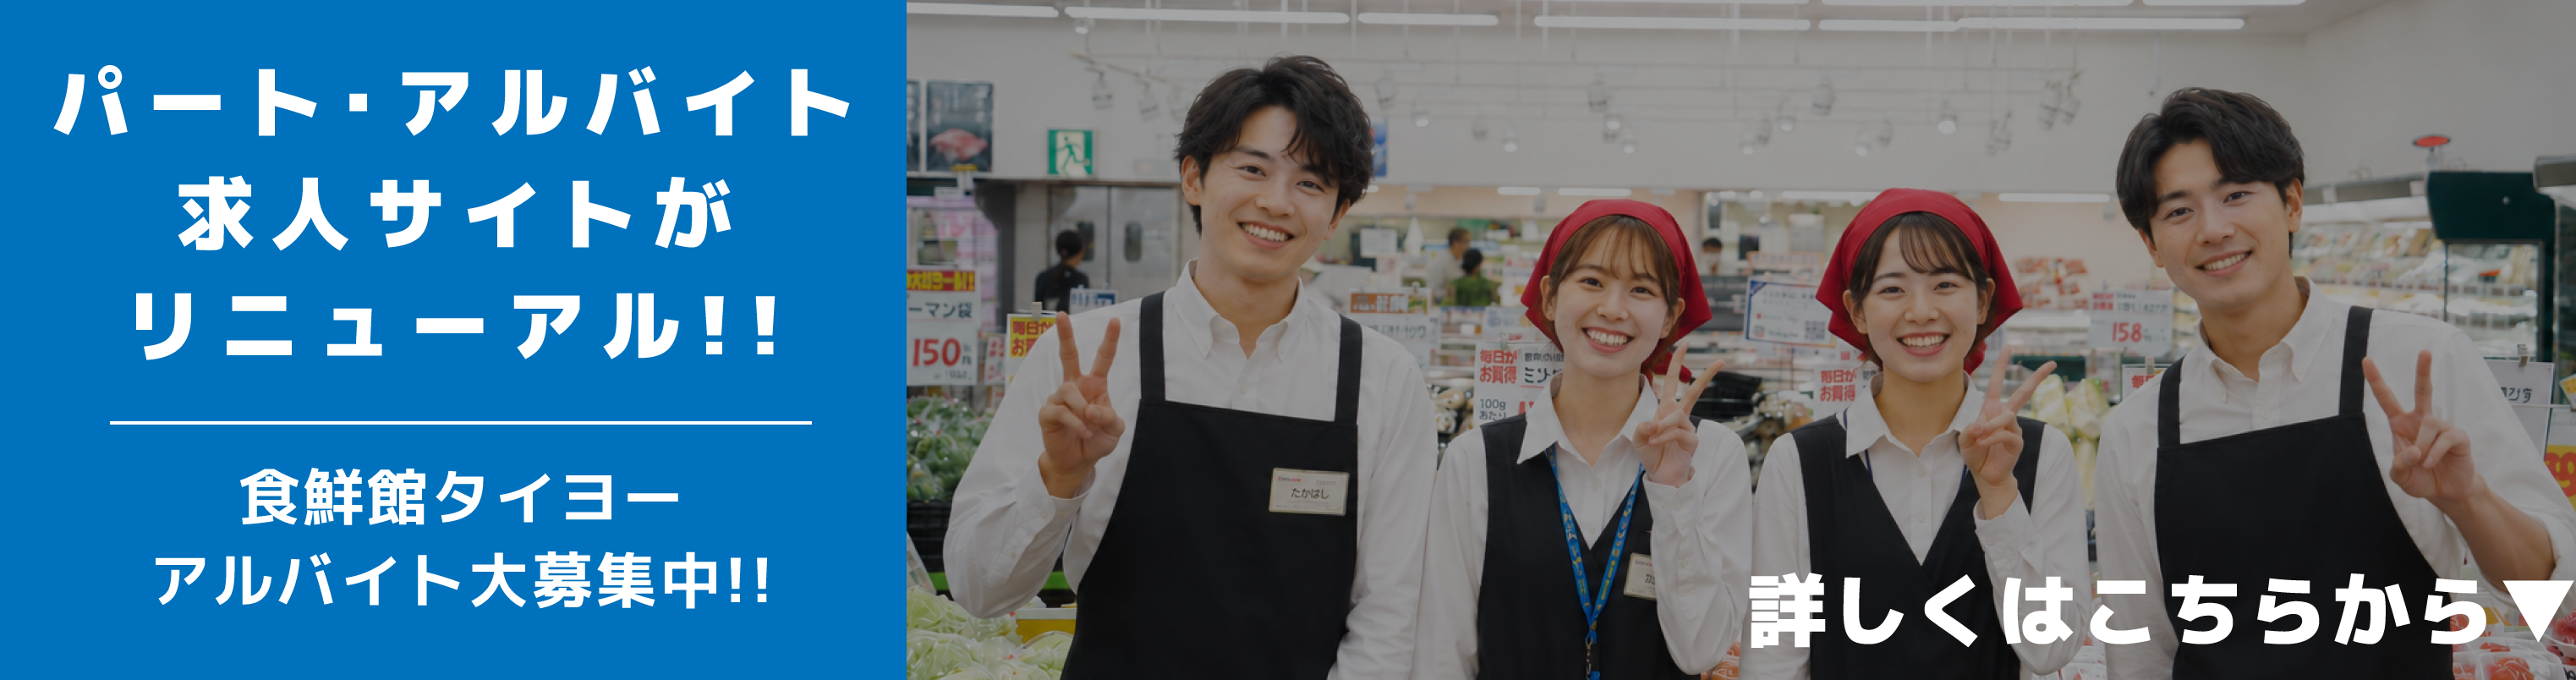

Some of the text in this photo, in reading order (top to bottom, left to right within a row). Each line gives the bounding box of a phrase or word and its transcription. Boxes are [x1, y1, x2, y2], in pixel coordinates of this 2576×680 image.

[907, 299, 973, 318] ーマン袋
[2112, 322, 2143, 343] 158
[913, 337, 962, 367] 150
[1479, 349, 1518, 365] 毎日が
[1479, 365, 1518, 384] お買得
[1479, 399, 1506, 411] 100g
